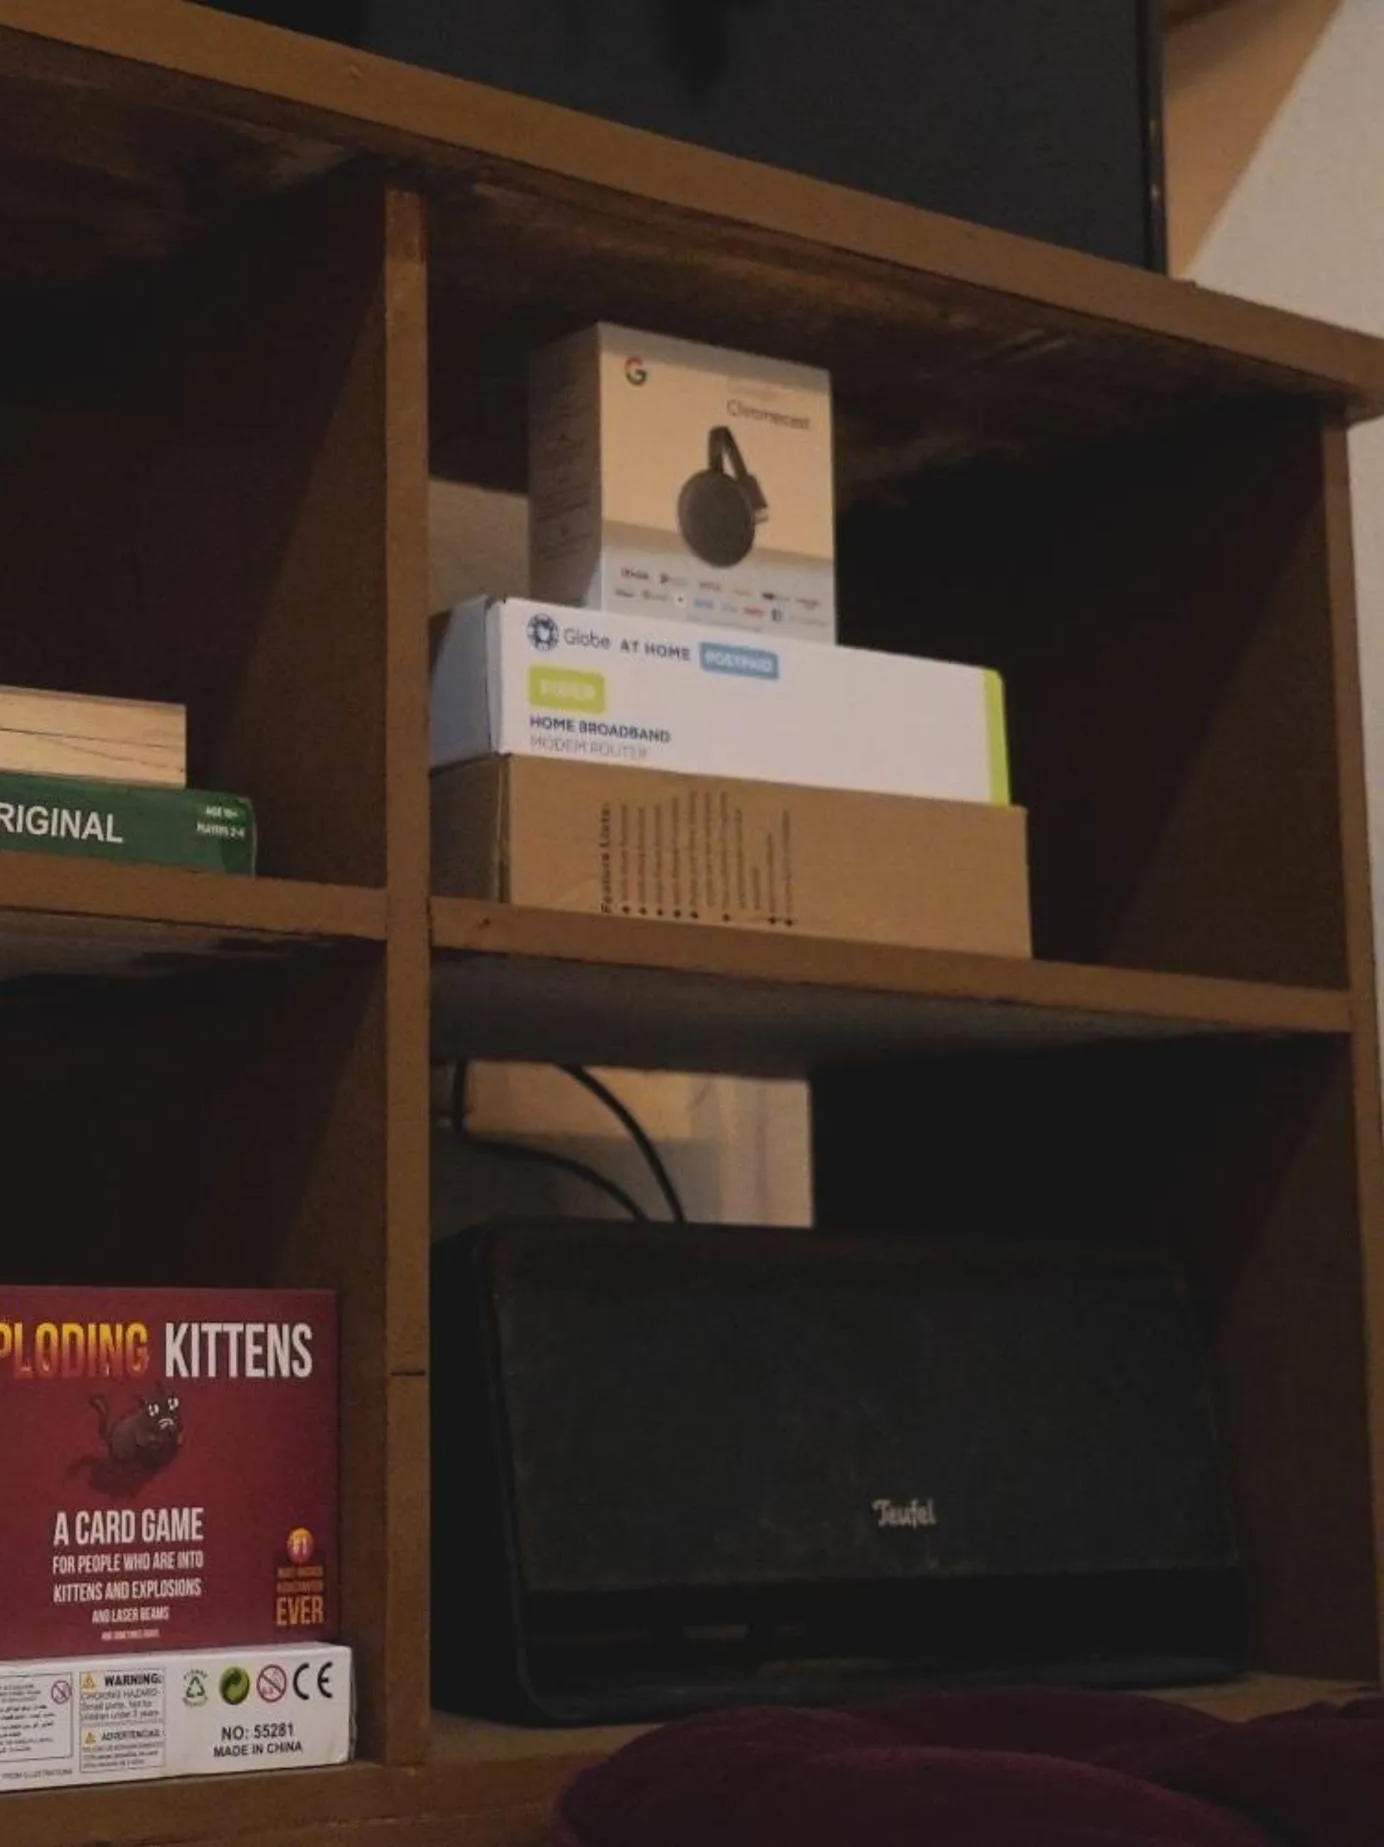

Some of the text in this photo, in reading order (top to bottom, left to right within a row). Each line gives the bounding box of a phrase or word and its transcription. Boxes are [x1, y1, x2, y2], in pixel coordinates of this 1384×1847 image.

[727, 399, 810, 430] Chromecast
[564, 628, 773, 672] Globe AT HOME POSTPAID
[530, 716, 672, 744] HOME BROADBAND
[530, 736, 648, 759] MODEM ROUTER
[165, 1321, 313, 1378] KITTENS
[53, 1507, 204, 1546] A CARD GAME
[871, 1497, 937, 1529] Teufel
[53, 1549, 204, 1575] FOR PEOPLE WHO ARE INTO
[53, 1578, 203, 1603] KITTENS AND EXPLOSIONS
[92, 1606, 170, 1624] AND LASER BEAMS
[276, 1596, 324, 1626] EVER
[221, 1722, 294, 1741] NO: 55281
[213, 1741, 303, 1758] MADE IN CHINA
